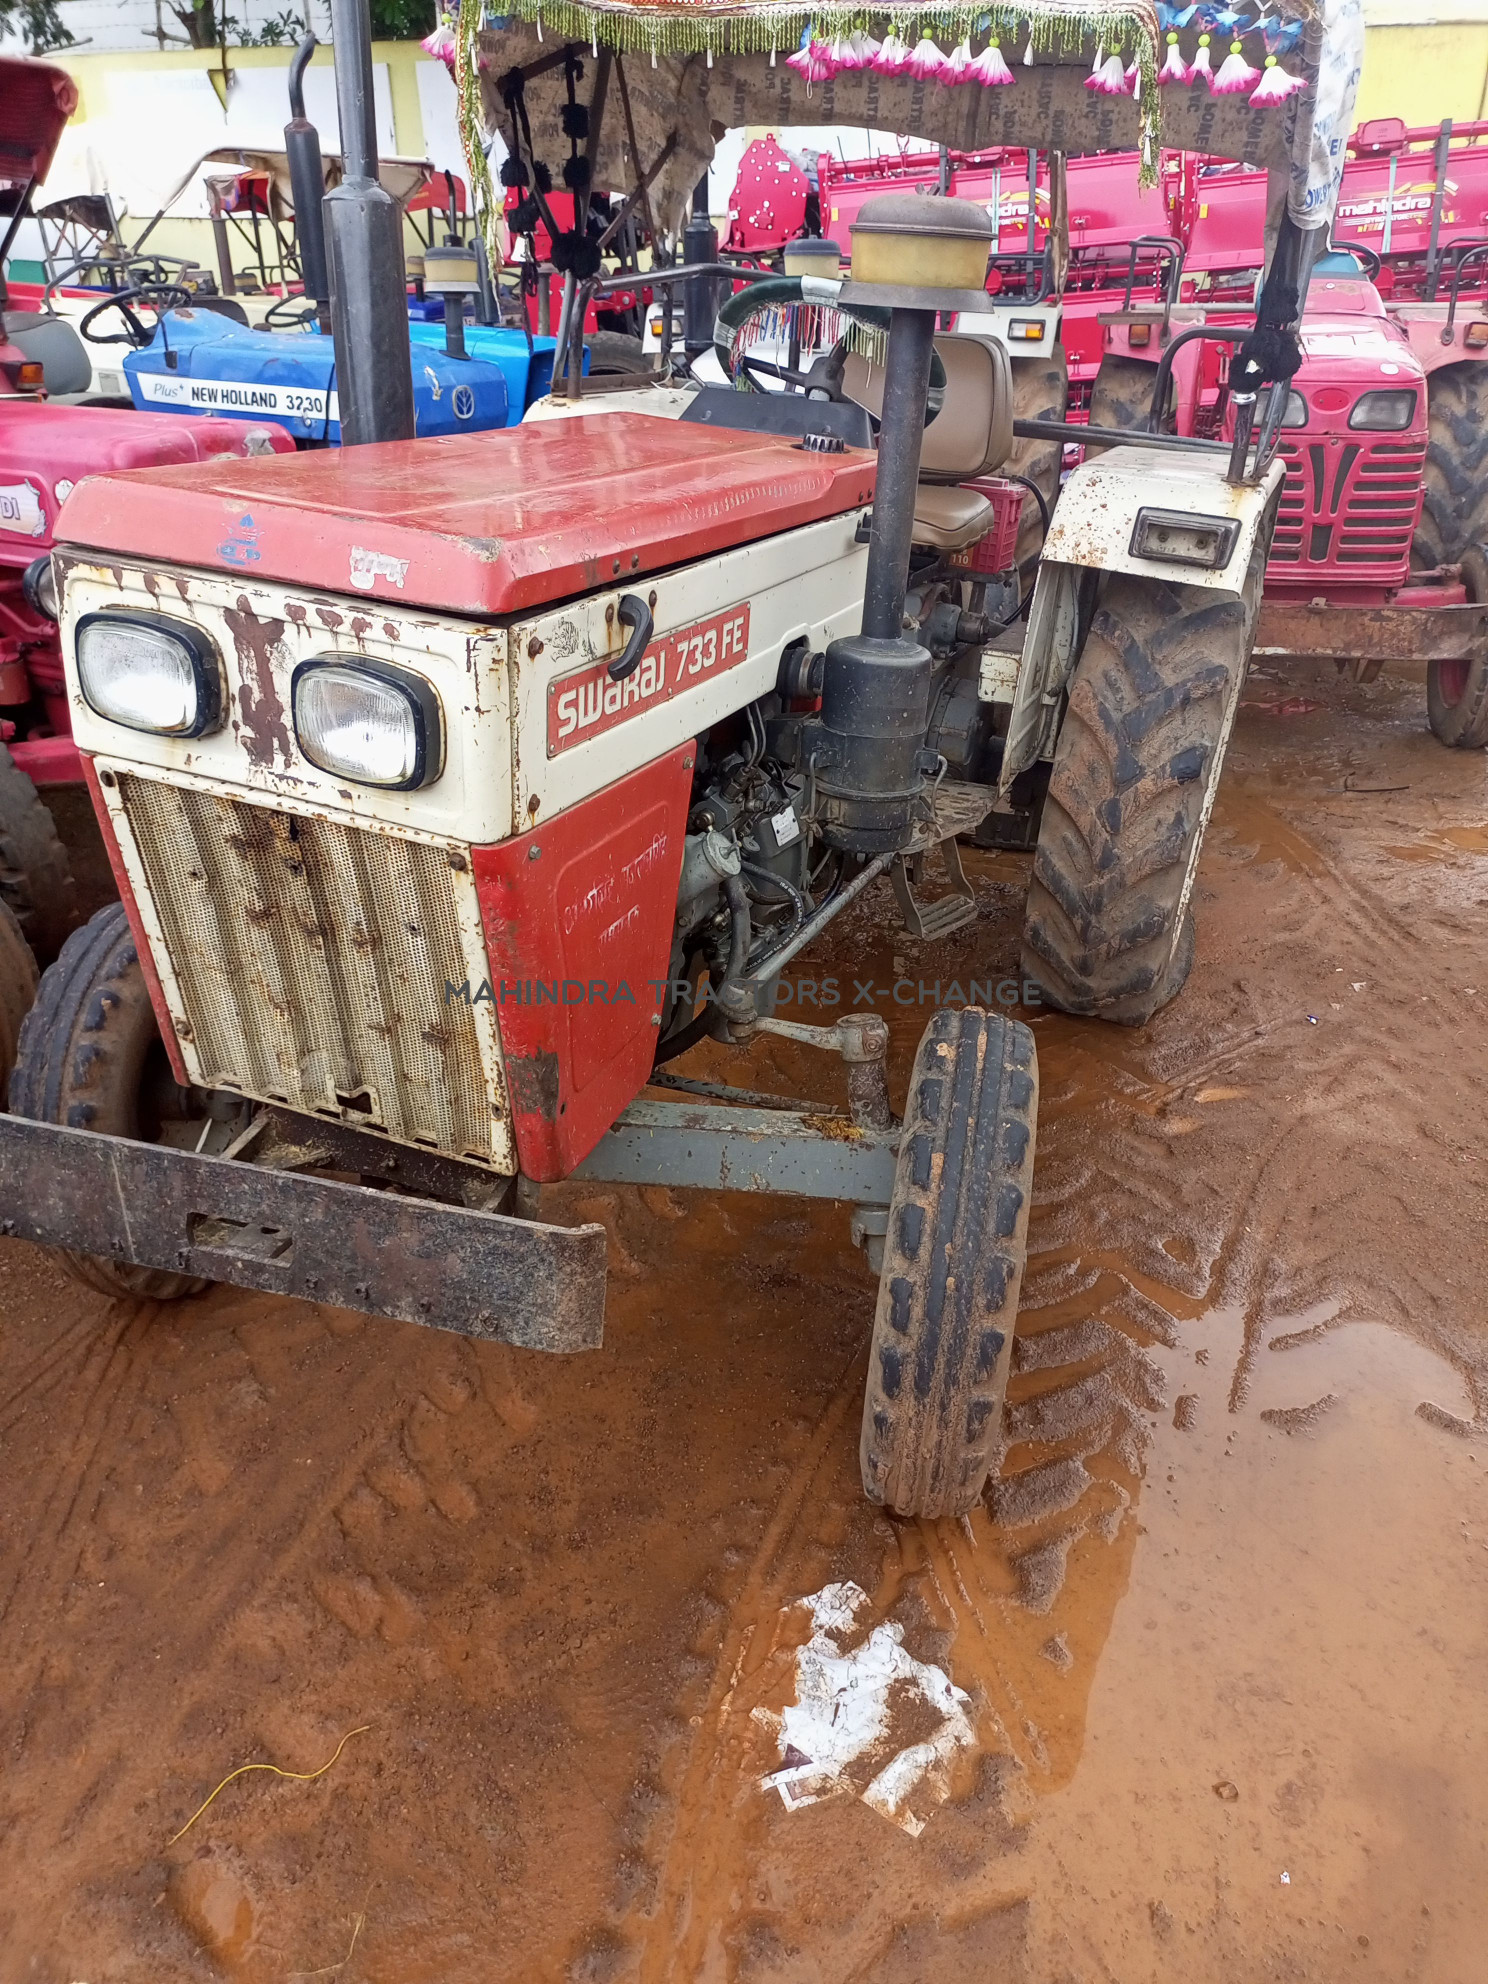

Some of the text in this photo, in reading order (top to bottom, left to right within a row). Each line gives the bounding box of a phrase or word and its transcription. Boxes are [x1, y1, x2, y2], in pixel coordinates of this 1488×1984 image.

[192, 387, 218, 403] NEW
[221, 389, 277, 409] HOLLAND
[286, 395, 323, 413] 3230
[676, 629, 718, 682] 733
[721, 616, 745, 660] FE
